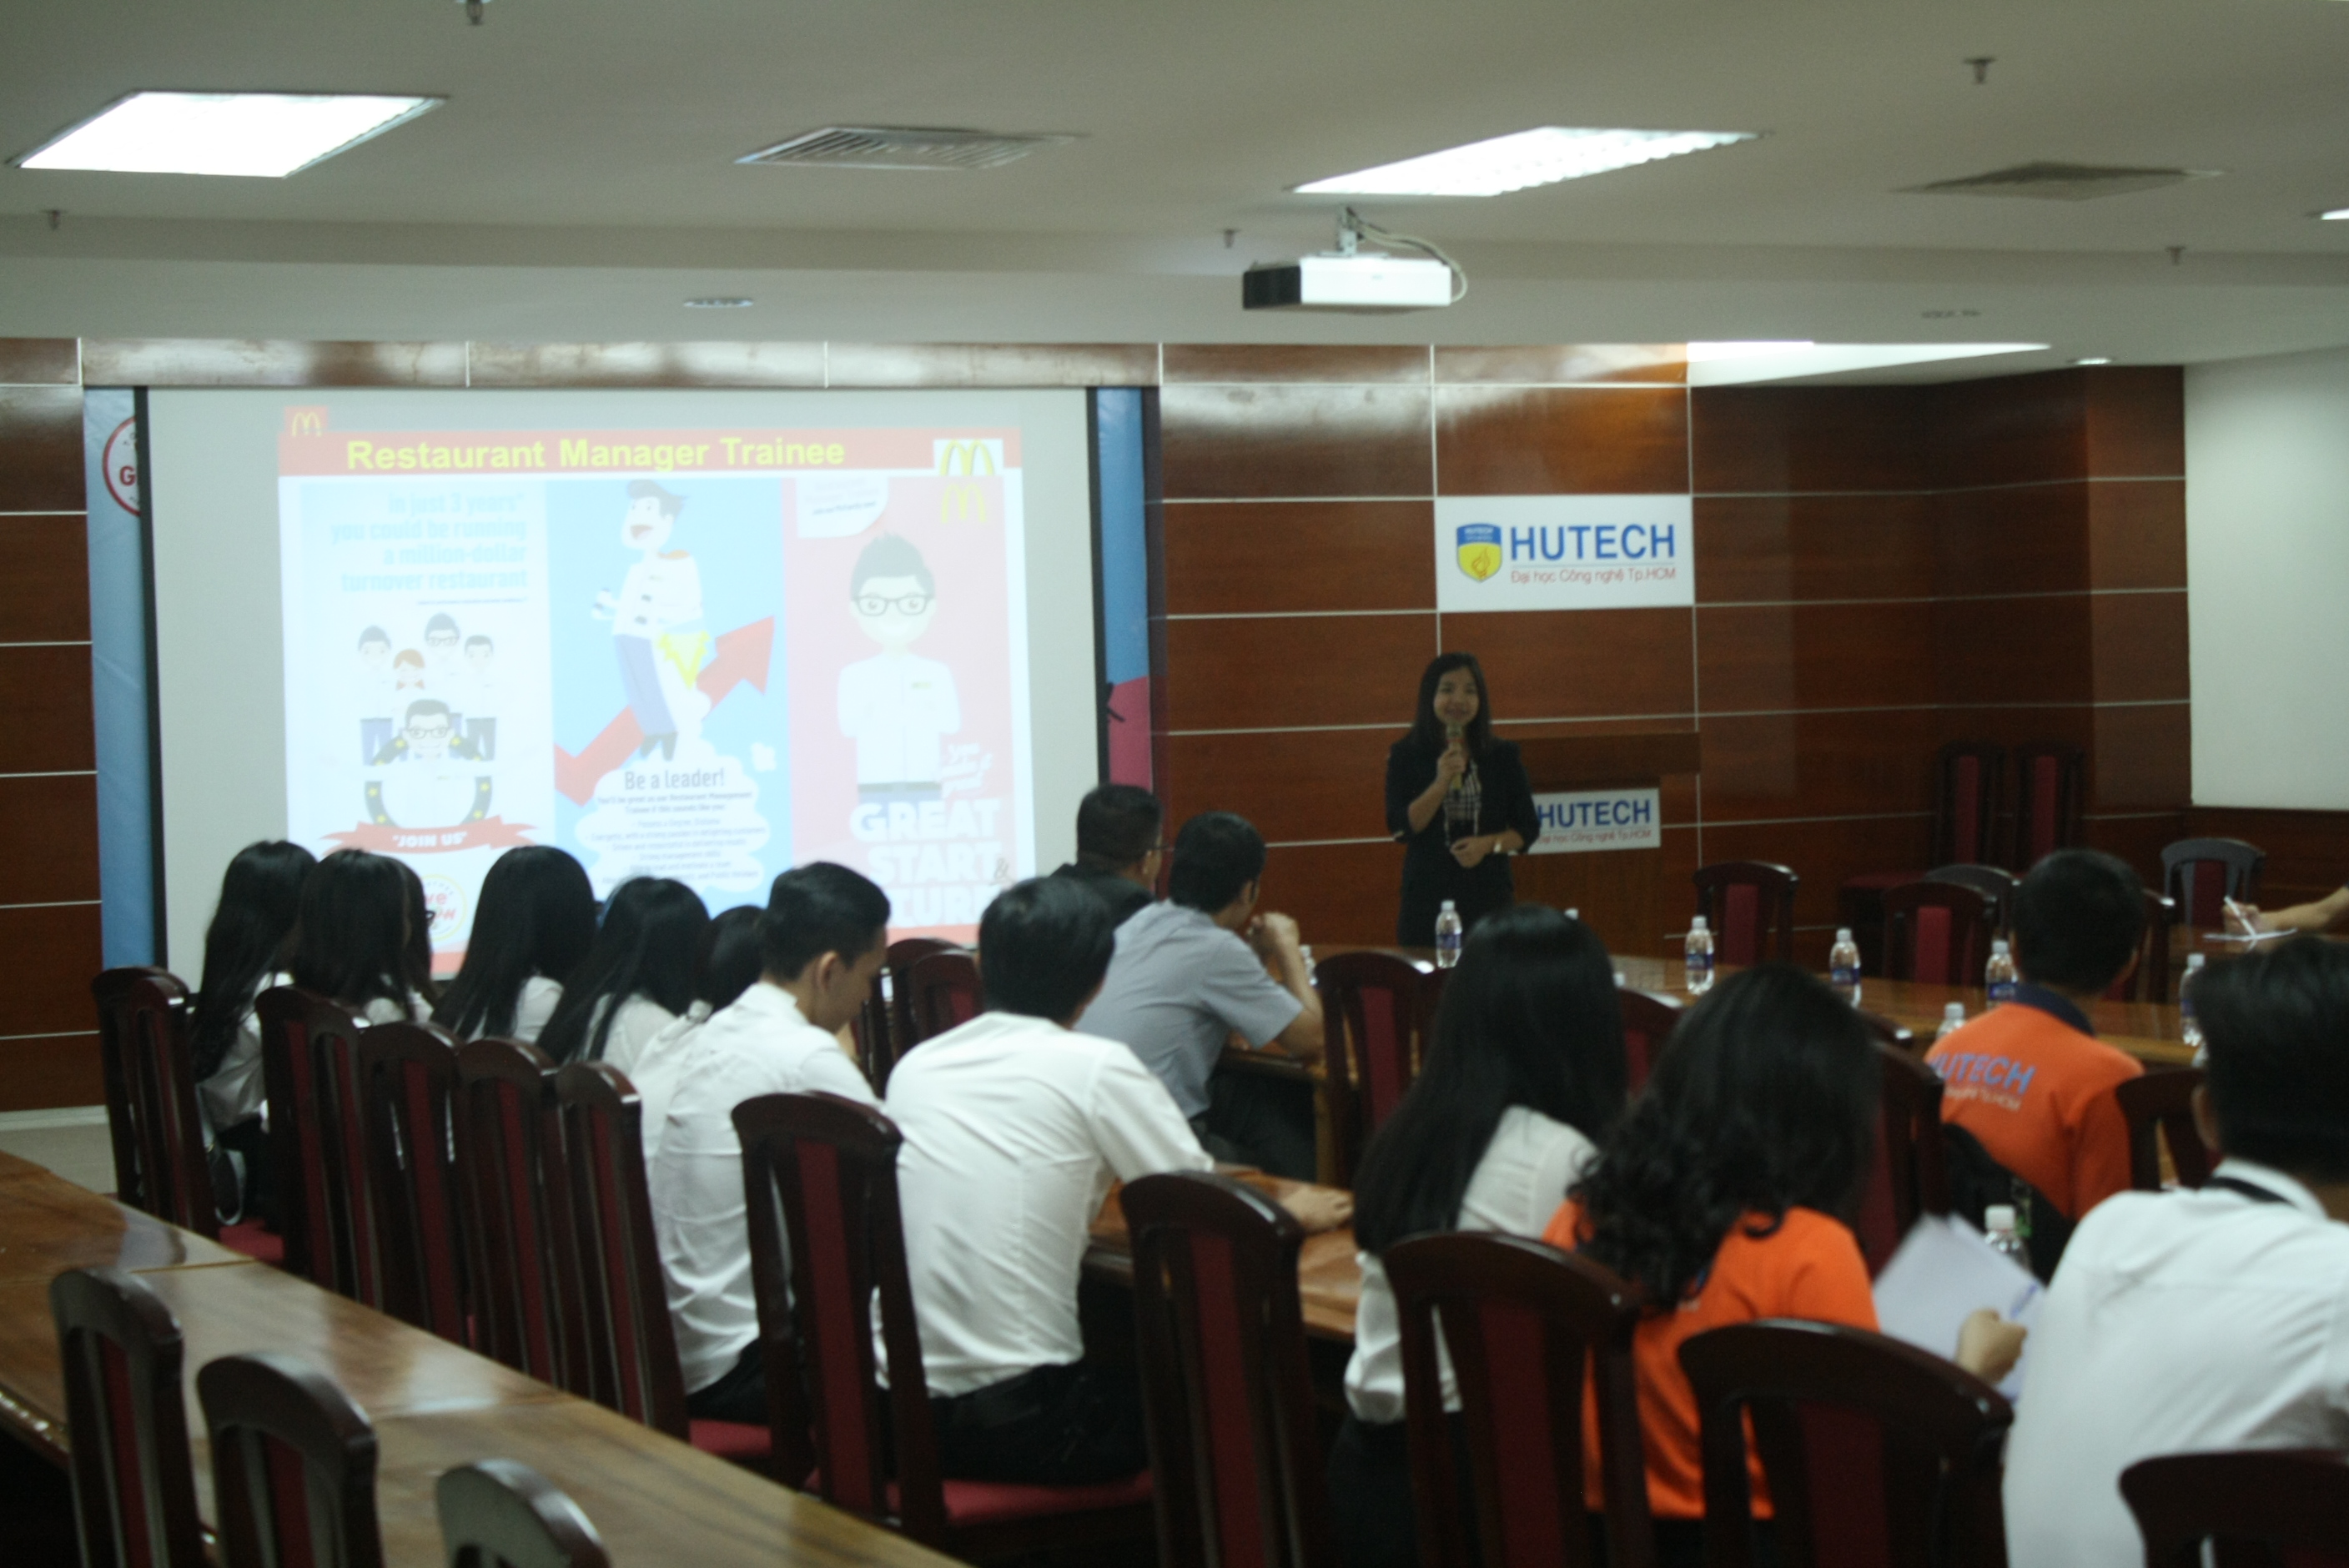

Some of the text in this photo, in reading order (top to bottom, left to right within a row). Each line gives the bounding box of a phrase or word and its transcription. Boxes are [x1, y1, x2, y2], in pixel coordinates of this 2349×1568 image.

[347, 436, 845, 472] Restaurant Manager Trainee
[410, 492, 445, 516] just
[450, 492, 462, 514] 3
[330, 516, 528, 545] you could be running
[1511, 524, 1675, 560] HUTECH
[383, 542, 528, 565] a million-dollar
[341, 569, 529, 592] turnover restaurant
[625, 766, 725, 791] Be a leader!
[849, 799, 1001, 843] GREAT
[1537, 798, 1652, 829] HUTECH
[868, 842, 1002, 885] START
[1929, 1053, 2037, 1095] UTECH
